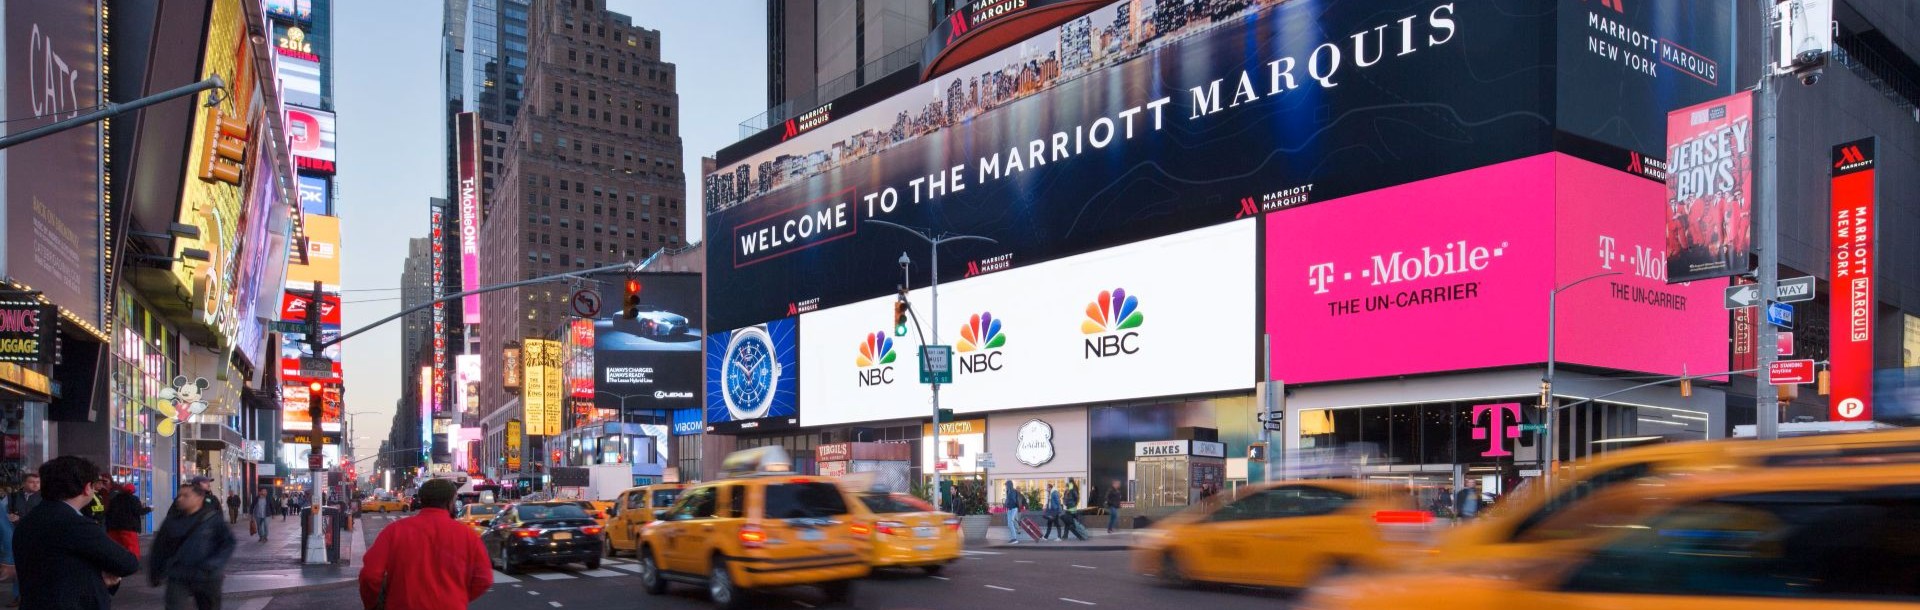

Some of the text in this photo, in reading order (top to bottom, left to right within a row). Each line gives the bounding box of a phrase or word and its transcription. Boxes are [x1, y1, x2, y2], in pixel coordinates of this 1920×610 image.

[973, 0, 1025, 25] MARQUIS
[280, 38, 311, 53] 2016
[1589, 11, 1715, 80] MARRIOTT MARQUIS
[1589, 36, 1657, 78] NEW YORK
[30, 23, 78, 123] CATS
[800, 103, 833, 122] MARRIOTT
[741, 3, 1456, 256] WELCOME TO THE MARRIOTT MARQUIS
[800, 114, 830, 131] MARQUIS
[1668, 120, 1748, 175] JERSEY
[297, 156, 335, 172] HIBA
[1645, 156, 1666, 170] MARRIO
[1840, 159, 1873, 170] MARRIOTT
[1645, 166, 1667, 180] MARQUI
[1678, 159, 1735, 203] BOYS
[300, 190, 322, 204] DK
[1263, 184, 1313, 201] MARRIOTT
[1263, 194, 1307, 210] MARQUIS
[1838, 210, 1849, 278] NEW YORK
[981, 253, 1013, 265] MARRIOTT
[981, 261, 1010, 272] MARQUIS
[1854, 206, 1867, 341] MARRIOTT MARQUIS
[1328, 282, 1479, 316] THE UN-CARRIER
[1610, 282, 1687, 311] THE UN-CARRIER
[1779, 285, 1804, 296] WAY
[0, 309, 37, 333] ONICS
[1085, 332, 1140, 359] NBC
[960, 351, 1003, 375] NBC
[859, 366, 894, 388] NBC
[1846, 402, 1857, 415] P
[939, 421, 972, 434] NVICTA
[1472, 402, 1522, 457] T
[819, 444, 847, 456] VIRGIL'S
[1143, 445, 1180, 455] SHAKES
